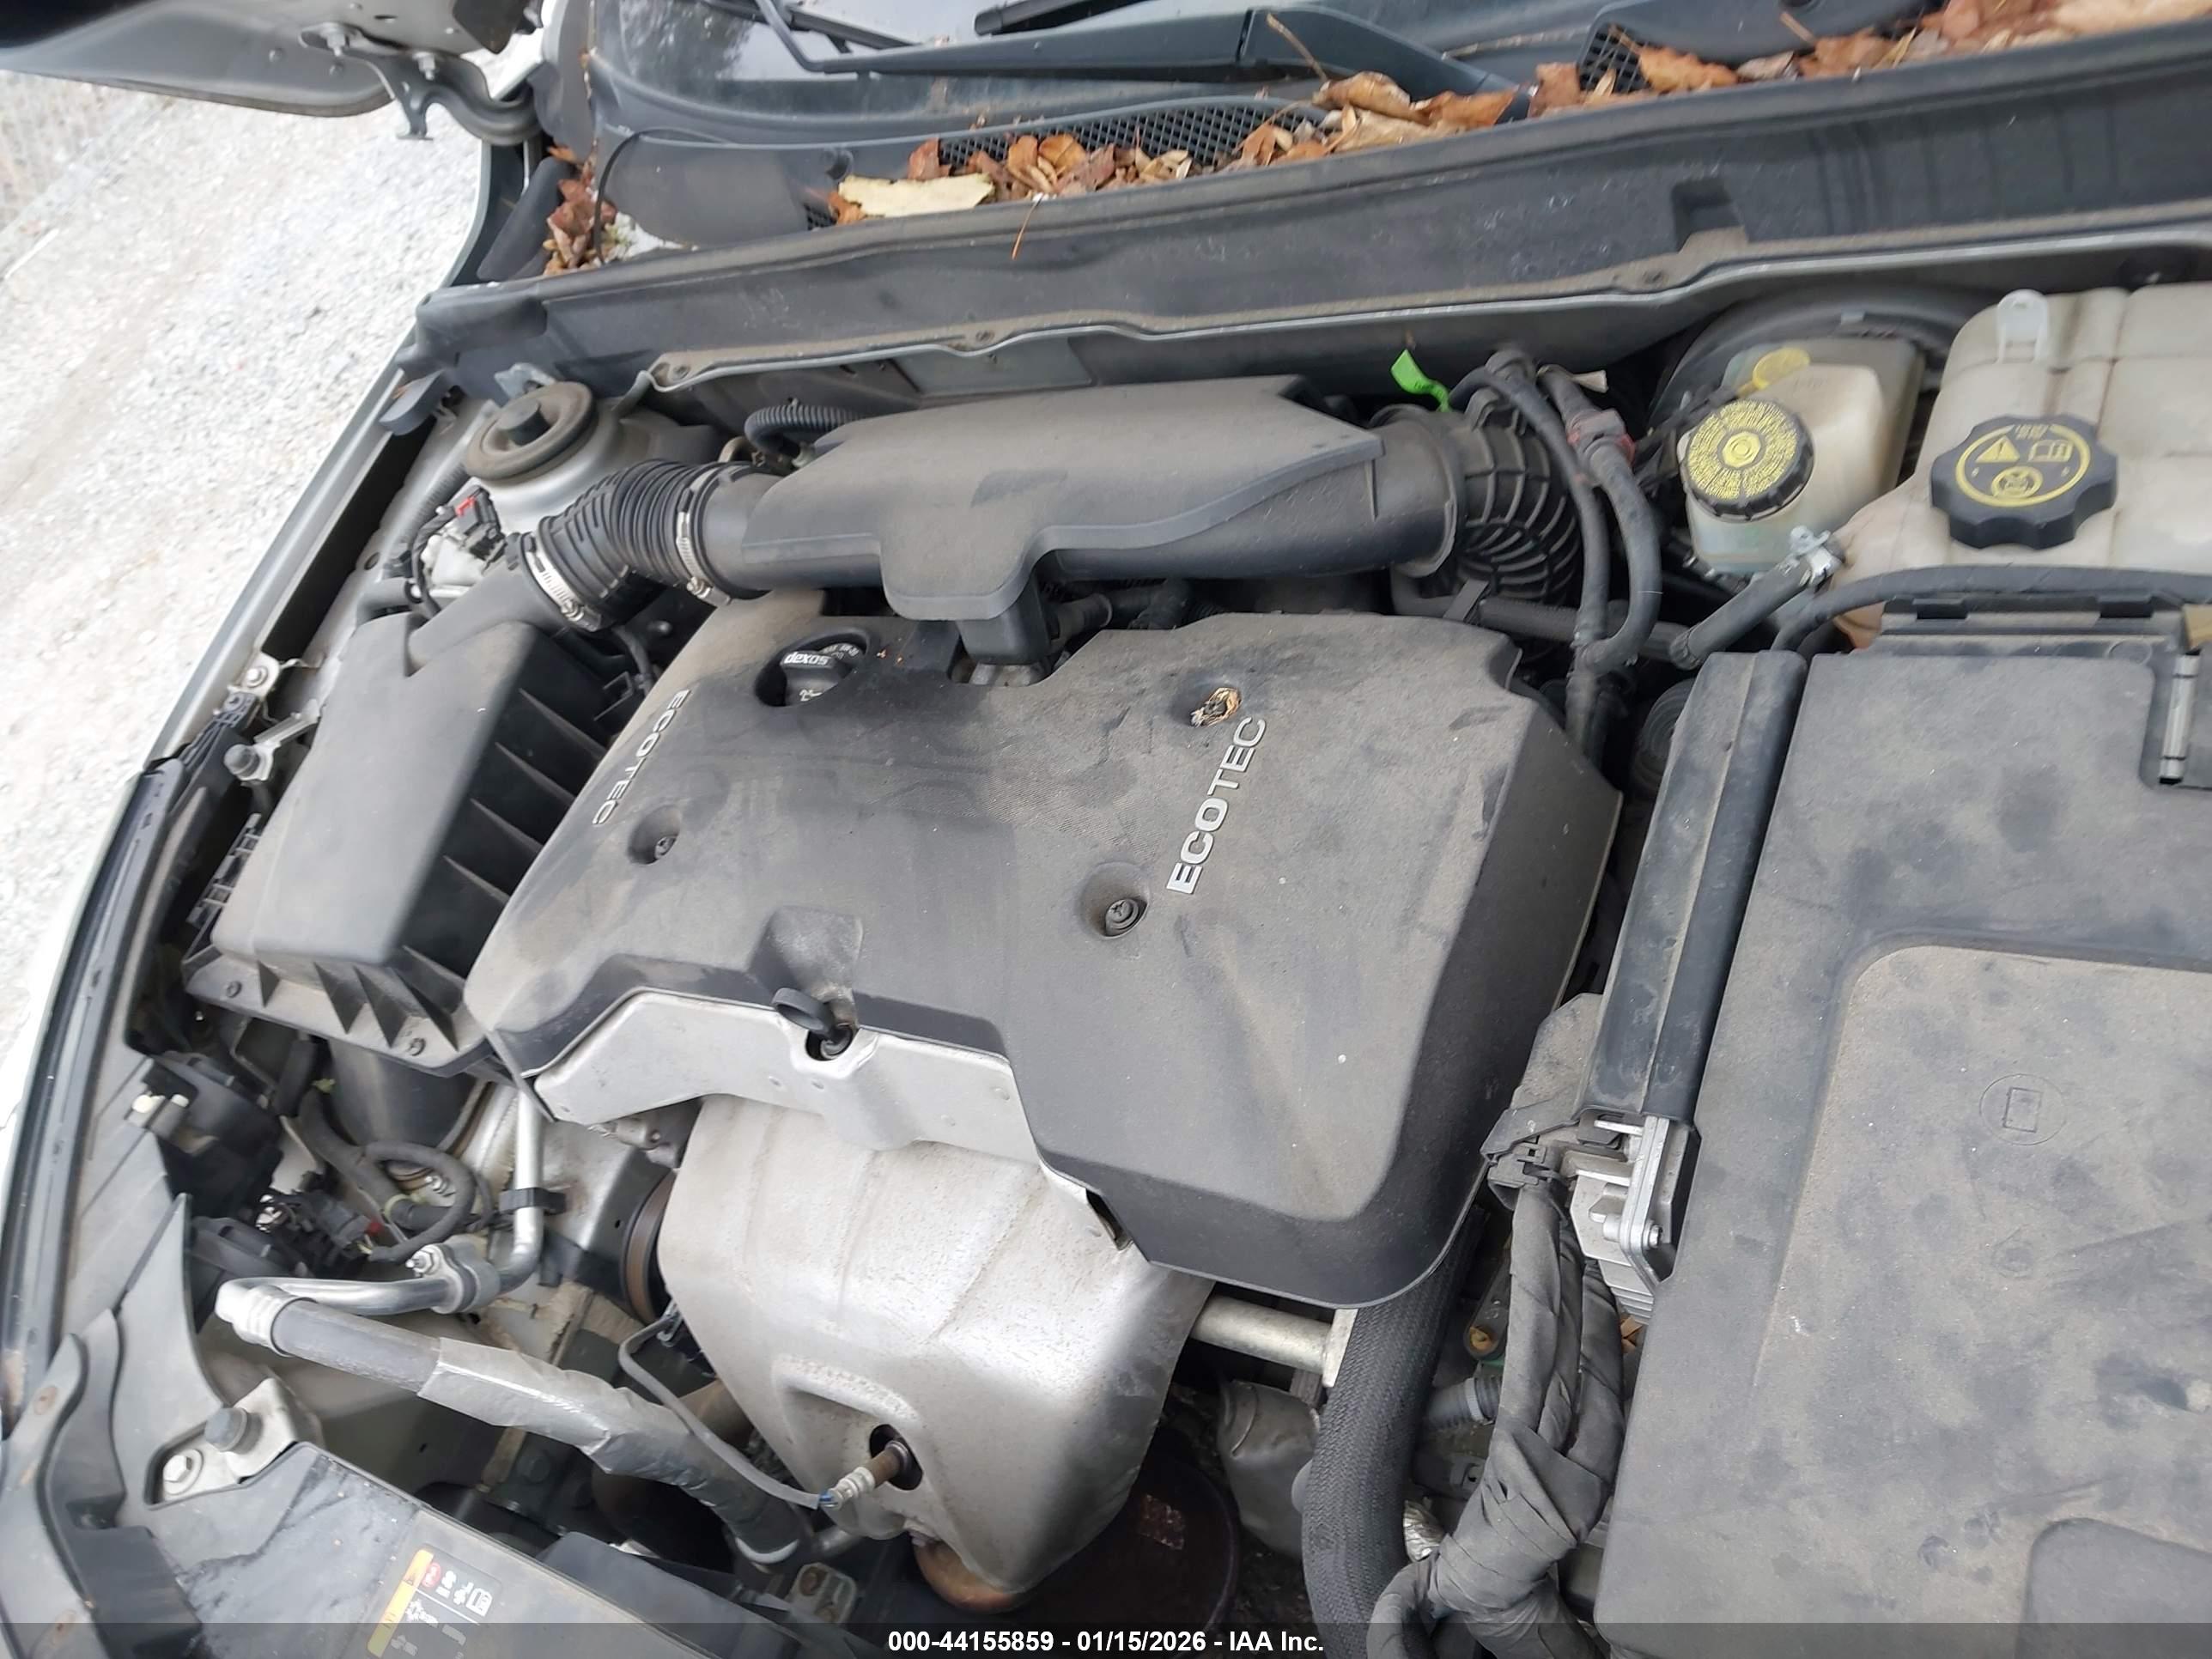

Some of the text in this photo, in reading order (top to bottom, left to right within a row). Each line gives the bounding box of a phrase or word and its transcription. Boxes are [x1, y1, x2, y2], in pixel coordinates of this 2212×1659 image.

[783, 651, 832, 665] dexos
[592, 689, 691, 825] ECOTEC
[1166, 716, 1267, 894] ECOTEC
